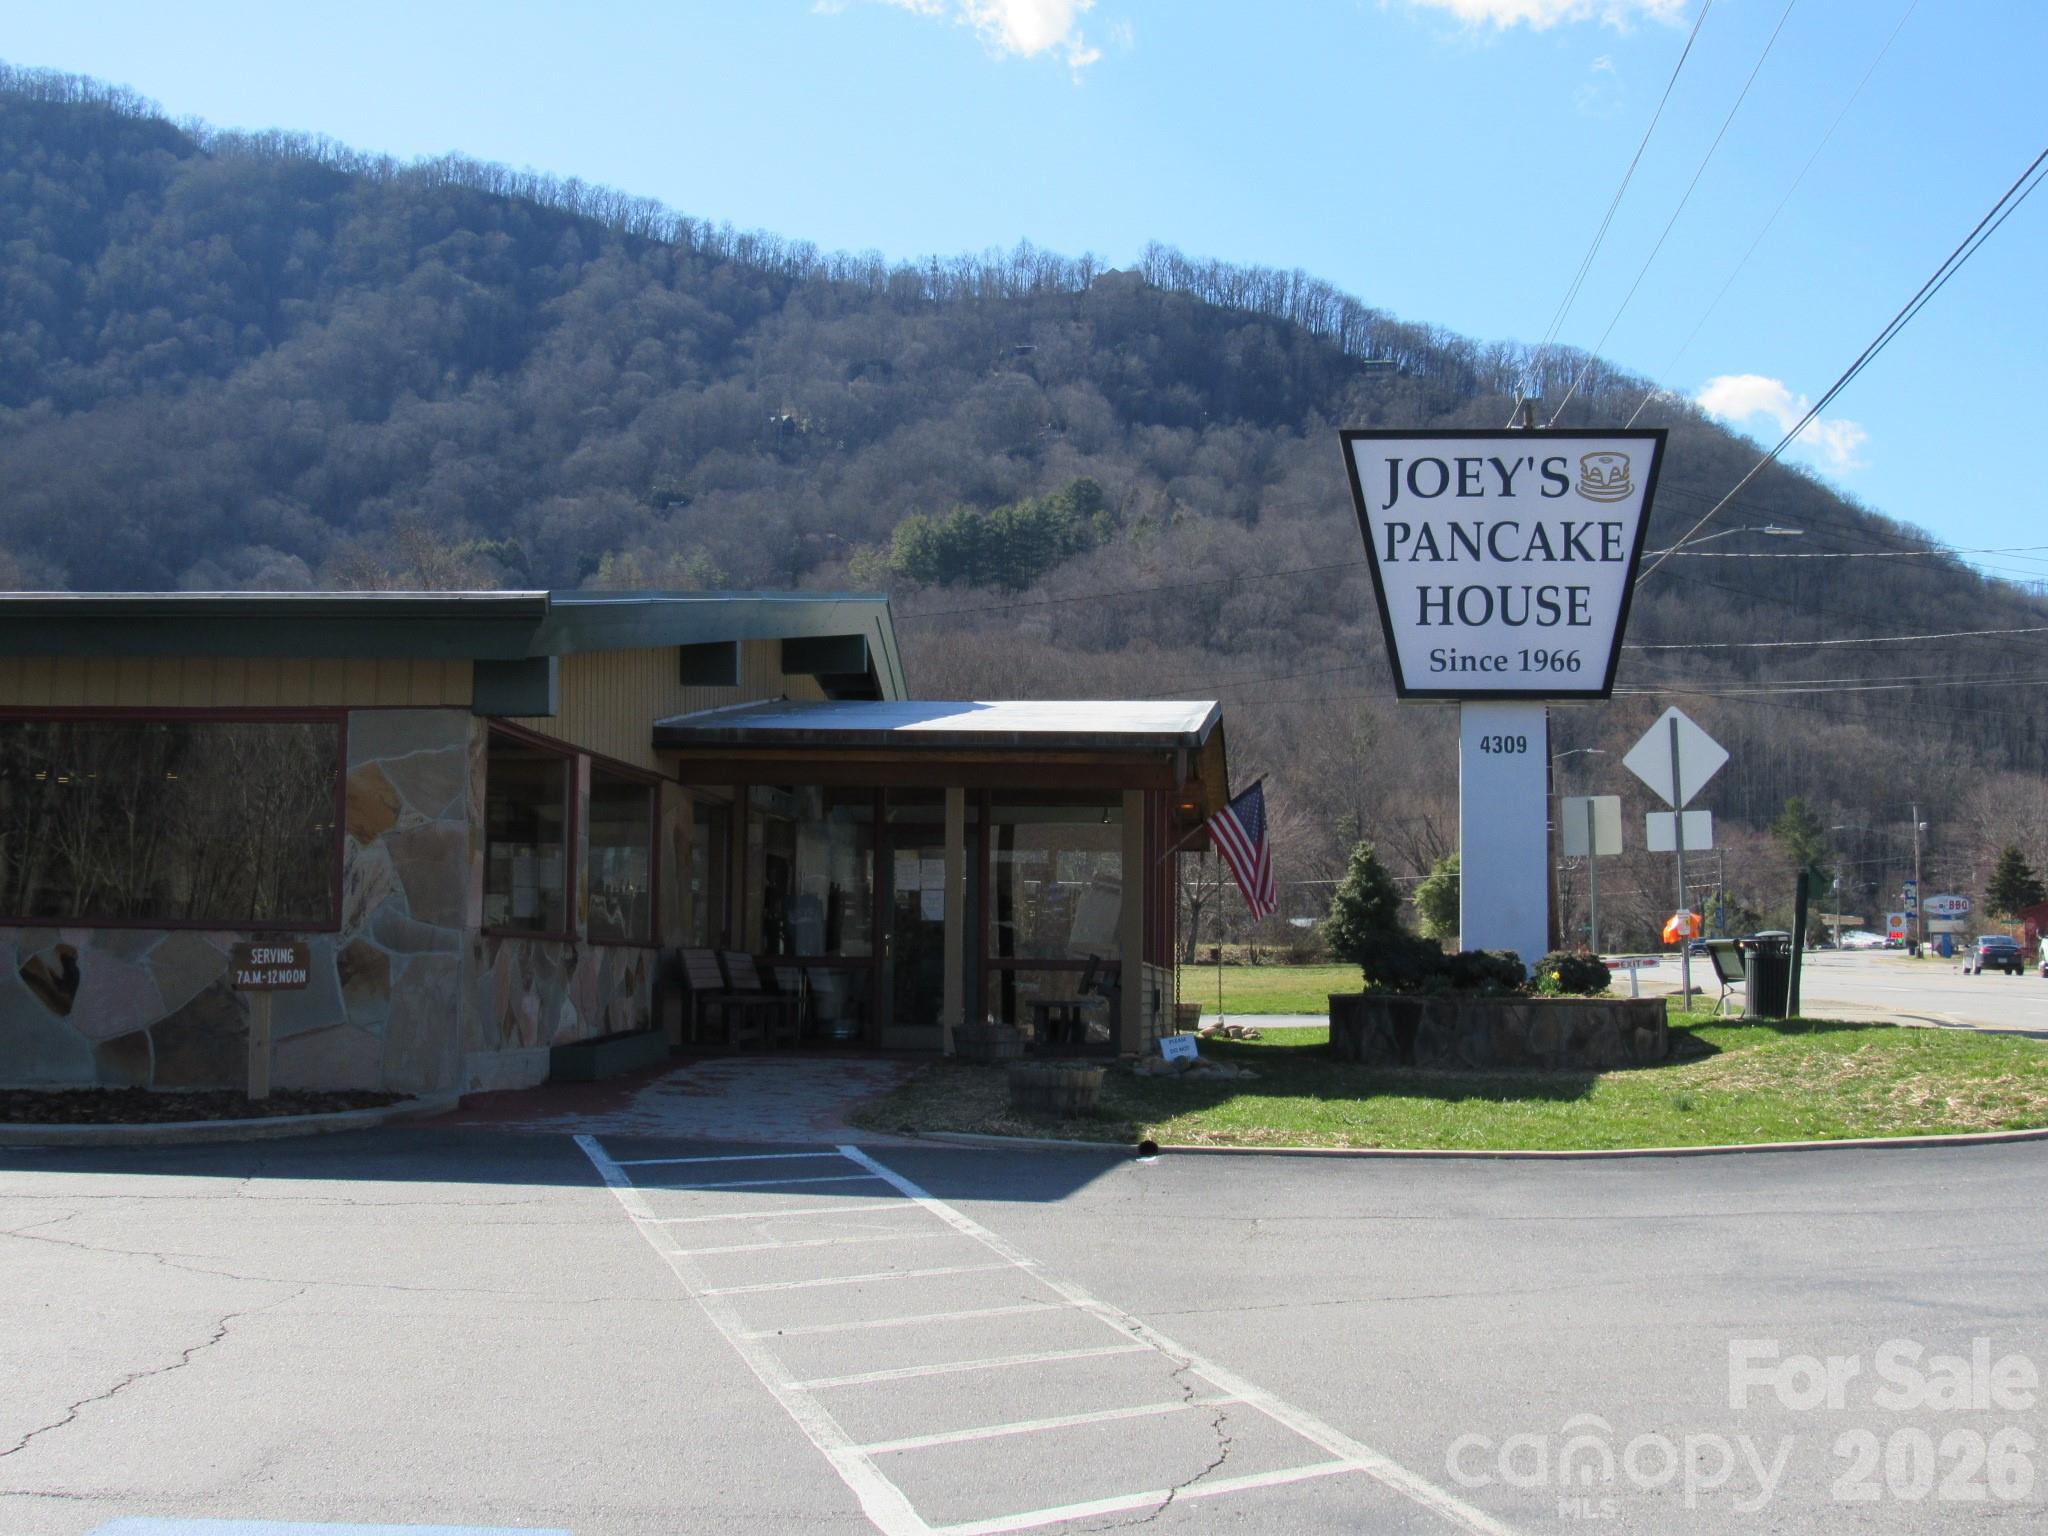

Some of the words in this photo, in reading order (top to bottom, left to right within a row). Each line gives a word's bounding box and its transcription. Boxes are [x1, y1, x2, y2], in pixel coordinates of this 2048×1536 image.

[1382, 456, 1570, 510] JOEY'S
[1383, 521, 1625, 563] PANCAKE
[1415, 585, 1592, 627] HOUSE
[1429, 648, 1509, 673] Since
[1518, 648, 1582, 673] 1966
[1479, 735, 1528, 755] 4309
[1948, 900, 1968, 910] BBQ
[251, 948, 294, 965] SERVING
[1620, 959, 1641, 968] EXIT
